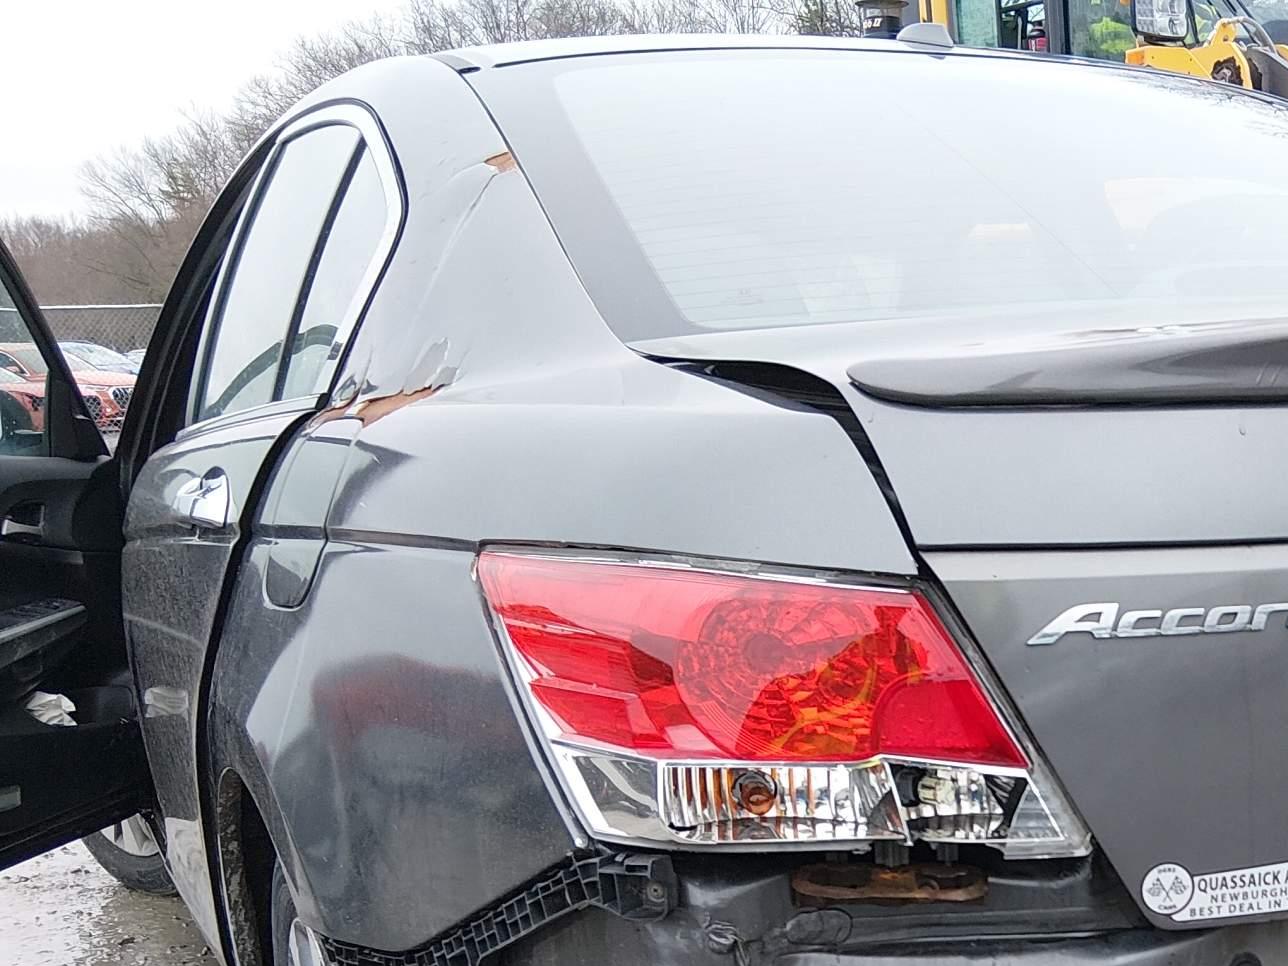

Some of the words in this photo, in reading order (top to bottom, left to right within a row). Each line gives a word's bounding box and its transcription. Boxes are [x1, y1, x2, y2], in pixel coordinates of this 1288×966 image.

[1197, 870, 1281, 893] QUASSAICK
[1210, 887, 1288, 904] NEWBURGH
[1189, 906, 1223, 918] BEST
[1228, 902, 1261, 914] DEAL
[1268, 899, 1282, 909] IN
